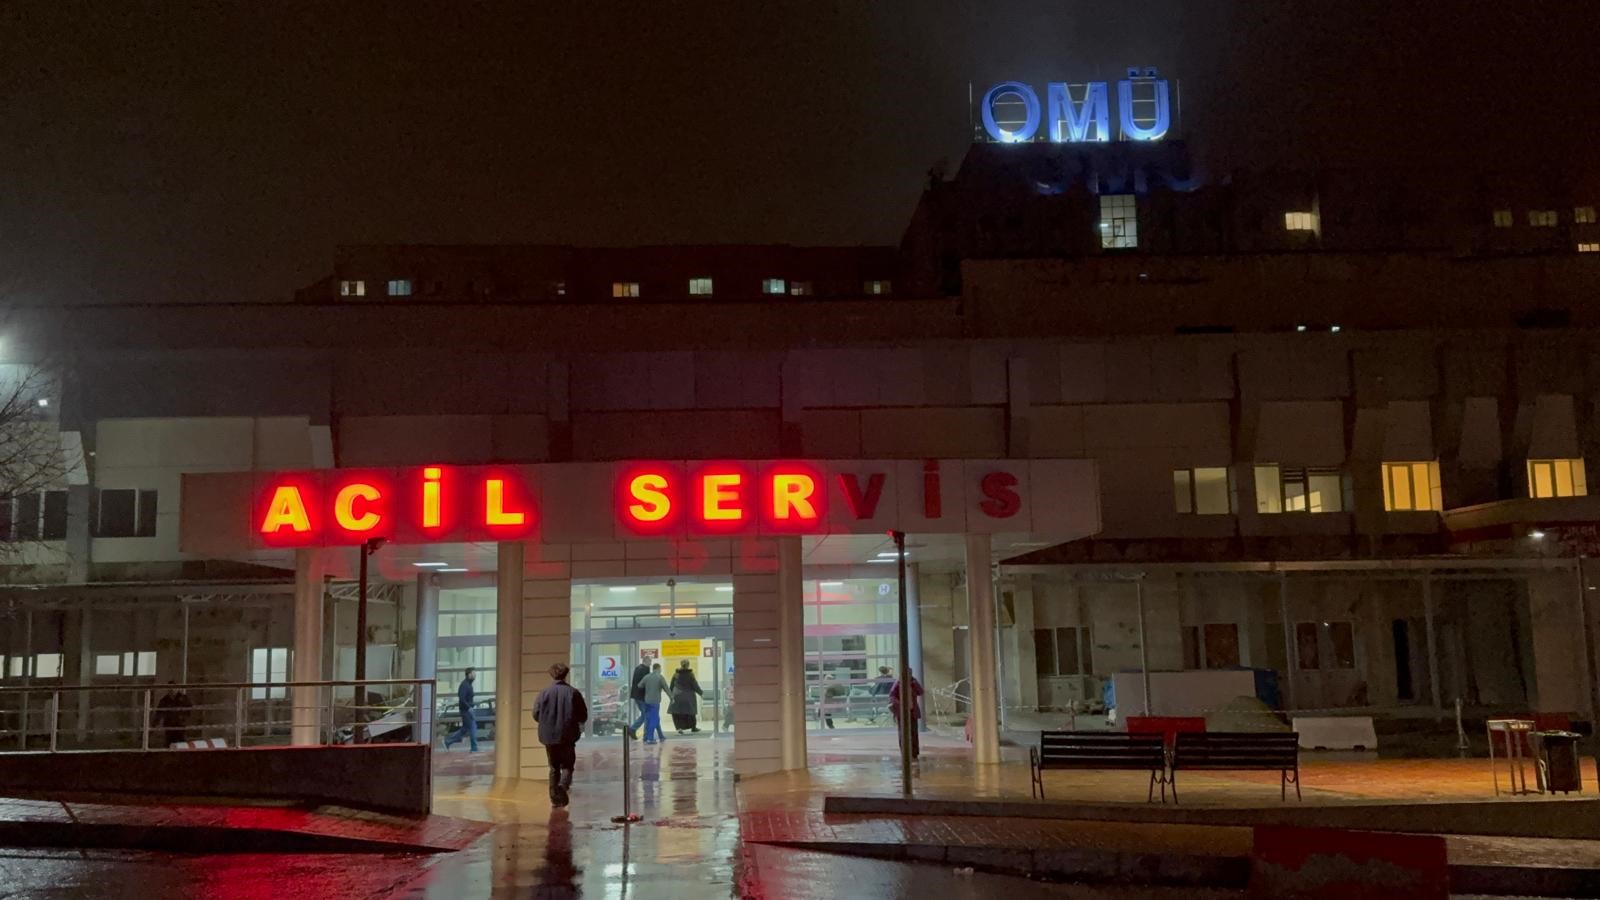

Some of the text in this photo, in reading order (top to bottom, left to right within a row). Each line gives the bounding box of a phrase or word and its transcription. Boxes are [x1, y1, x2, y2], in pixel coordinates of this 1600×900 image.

[981, 66, 1170, 143] OMÜ
[261, 458, 1022, 533] ACİL SERVİS
